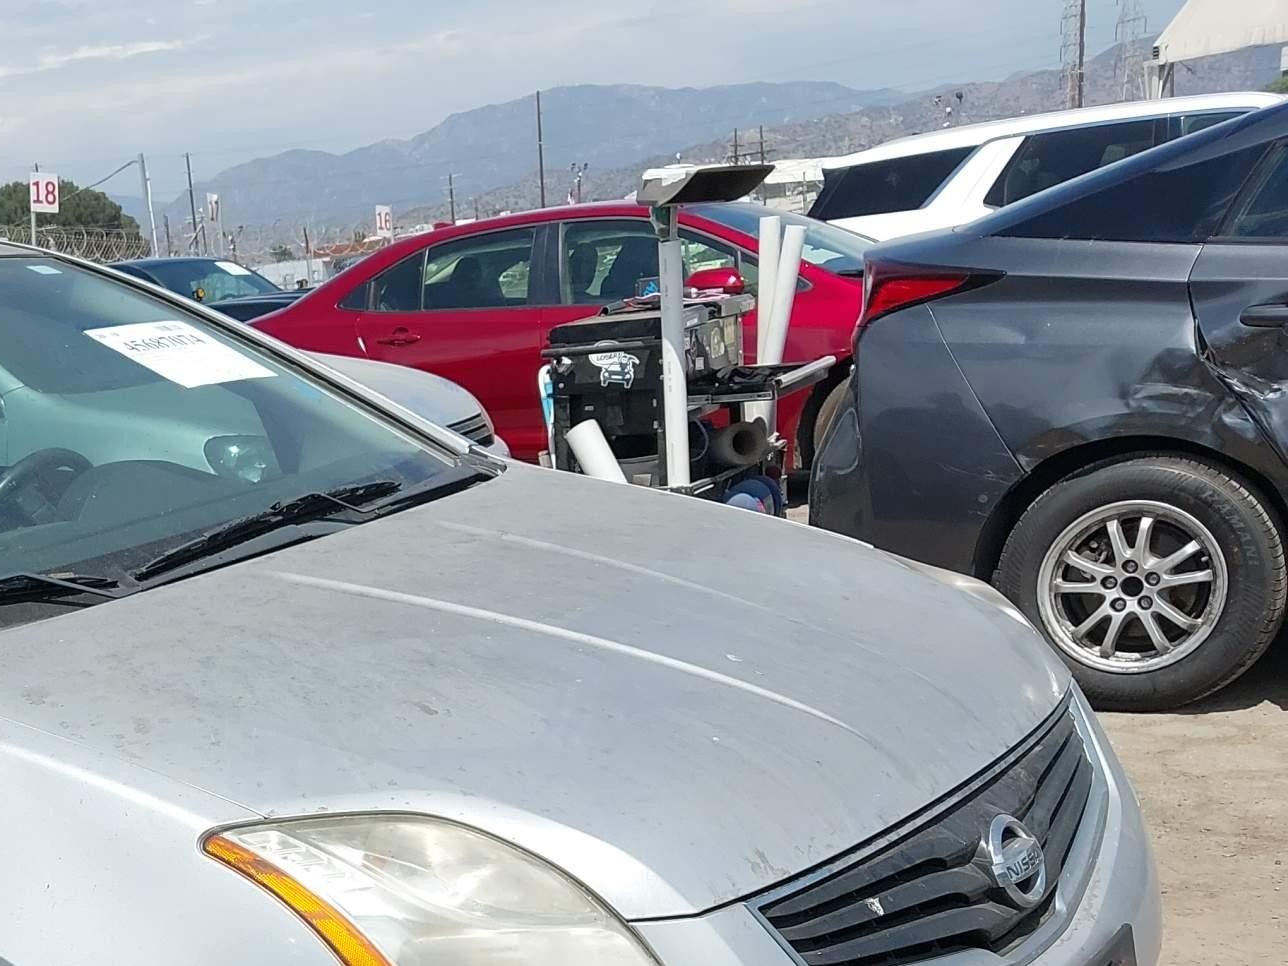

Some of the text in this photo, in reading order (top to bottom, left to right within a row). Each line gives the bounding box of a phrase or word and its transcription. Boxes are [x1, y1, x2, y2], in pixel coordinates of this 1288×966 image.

[32, 181, 56, 205] 18
[377, 212, 391, 231] 16
[123, 333, 207, 353] 45687074
[1006, 848, 1042, 879] NISSA
